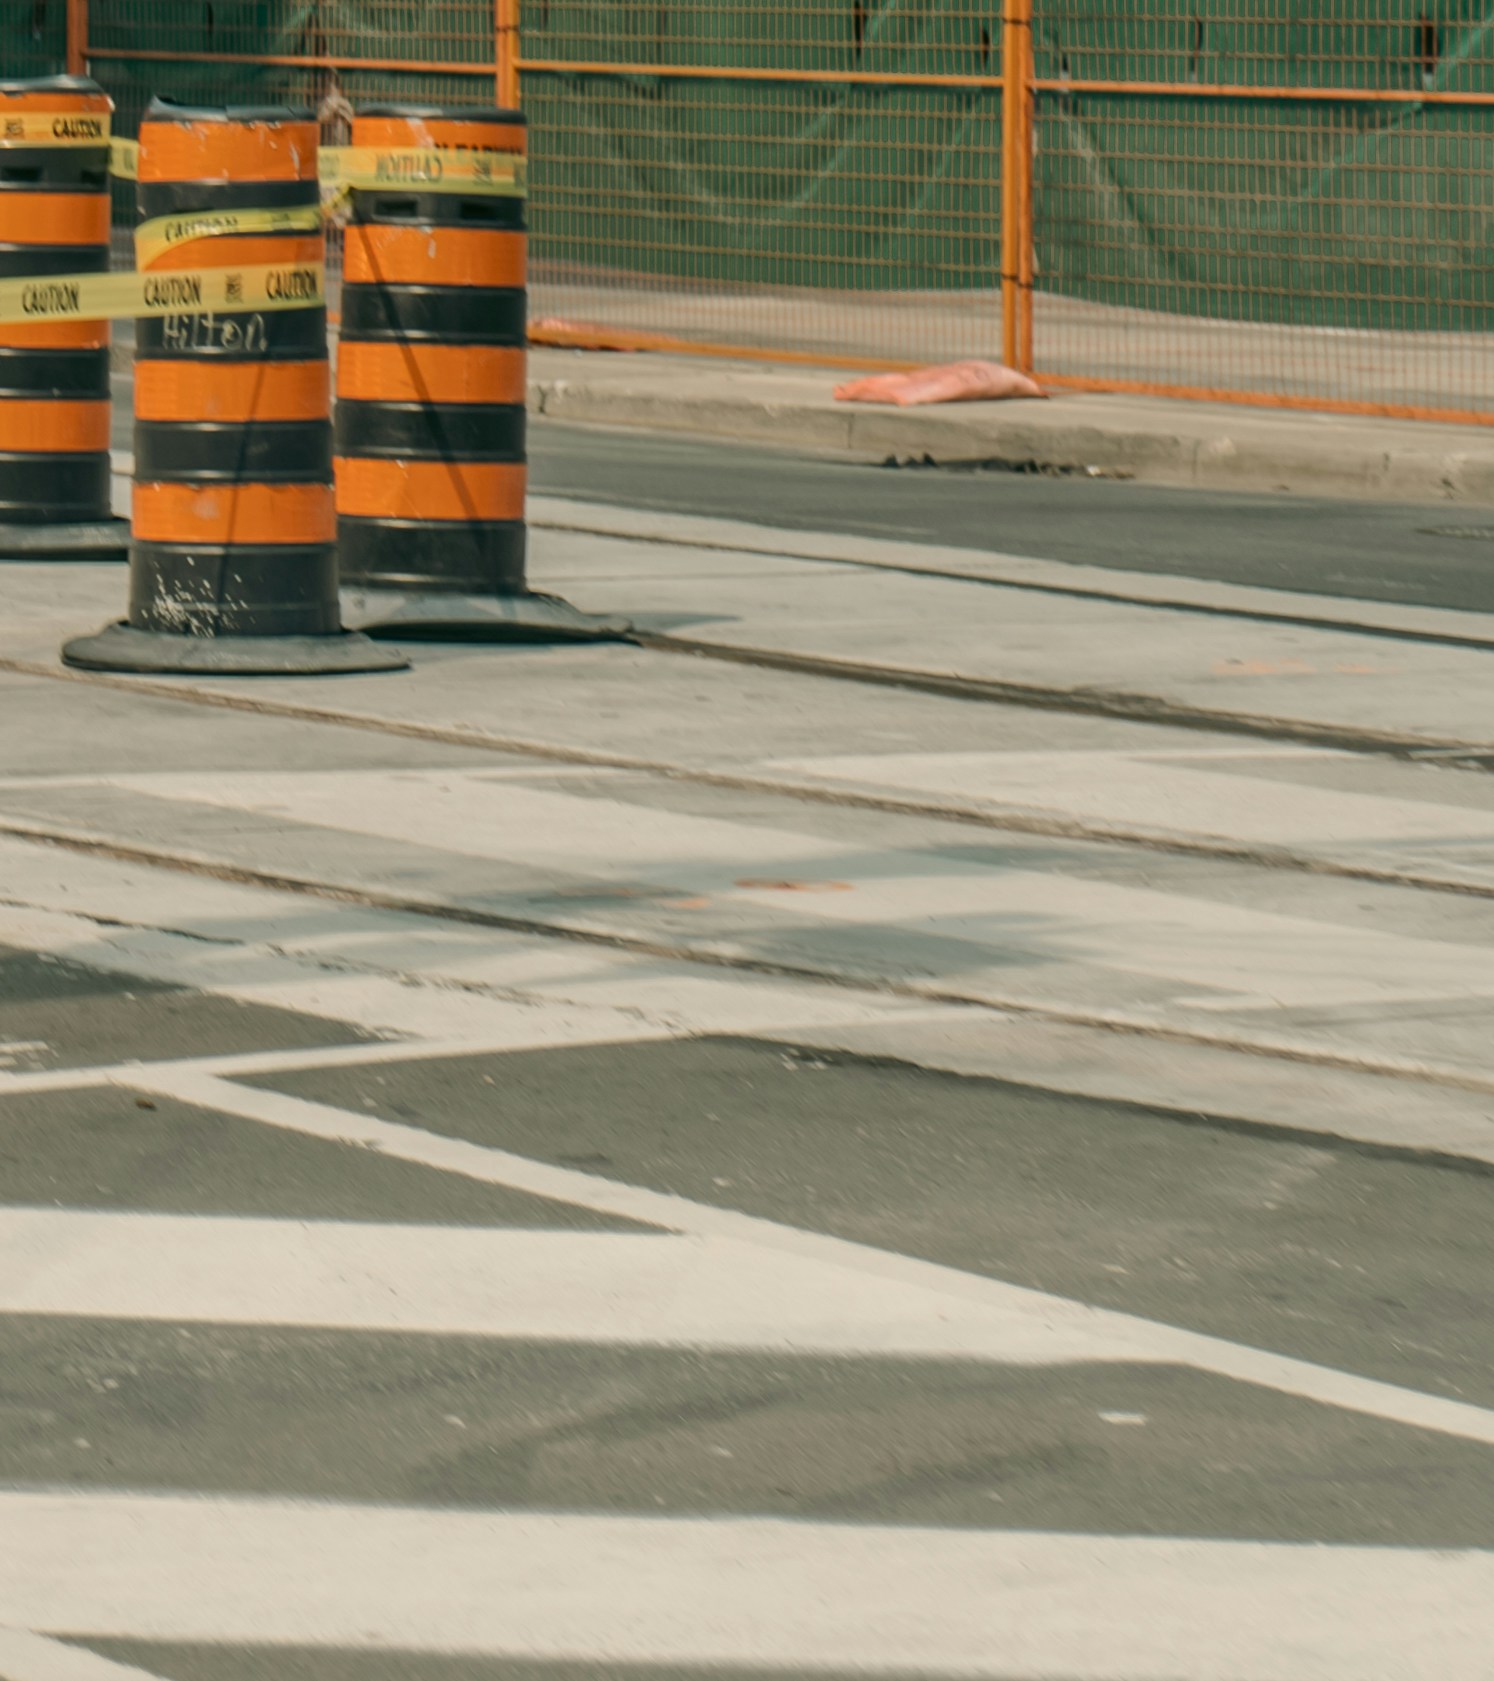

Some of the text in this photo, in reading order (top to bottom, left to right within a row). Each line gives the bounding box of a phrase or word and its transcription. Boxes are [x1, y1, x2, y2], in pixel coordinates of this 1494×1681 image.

[52, 119, 103, 139] CAUTION
[22, 282, 80, 315] CAUTION
[144, 275, 202, 307] CAUTION
[266, 269, 318, 301] CAUTION
